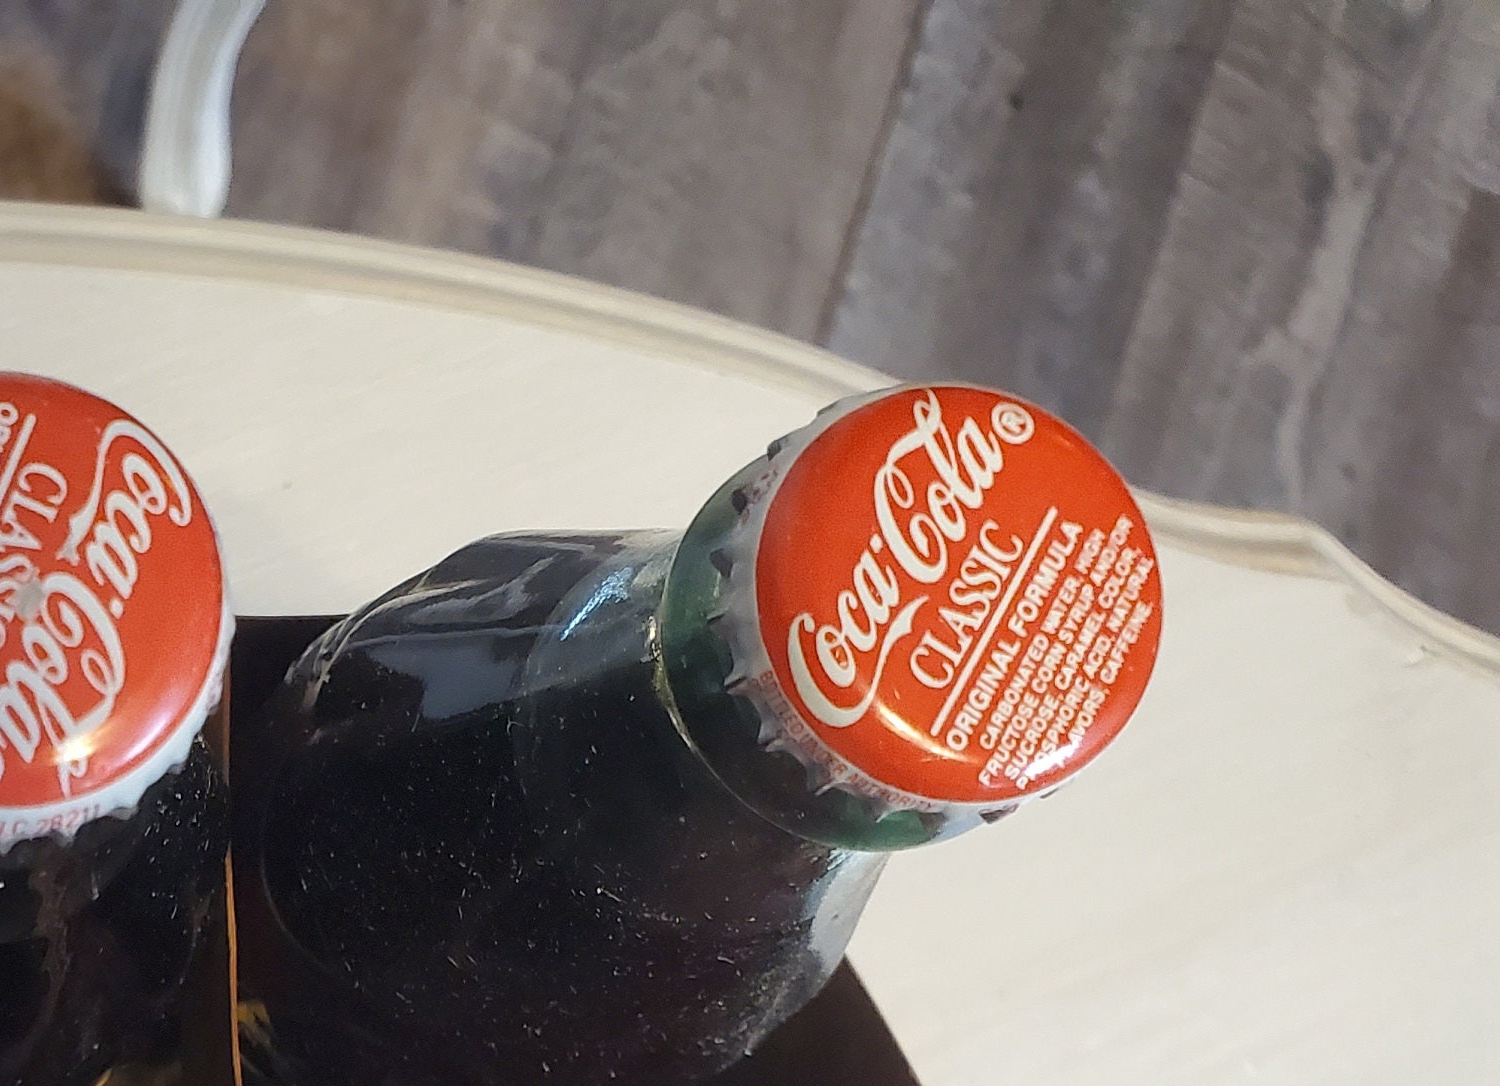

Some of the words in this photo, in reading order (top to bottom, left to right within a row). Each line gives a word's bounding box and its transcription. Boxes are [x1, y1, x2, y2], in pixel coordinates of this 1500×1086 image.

[785, 387, 1007, 724] Coca-Cola
[899, 517, 1030, 695] CLASSIC
[940, 632, 1025, 754] ORIGINAL
[1002, 515, 1089, 639] FORMULA
[974, 631, 1055, 751] CARBONATED
[1071, 526, 1108, 574] HIGH
[976, 689, 1043, 788] FRUCTOSE
[1027, 639, 1069, 695] CORN
[1053, 581, 1102, 645] SYRUP
[1084, 512, 1138, 587] AND/OR
[1013, 674, 1093, 794] POSPHORIC
[1102, 553, 1158, 633] NATURAL
[1049, 606, 1109, 692] CARAMEL
